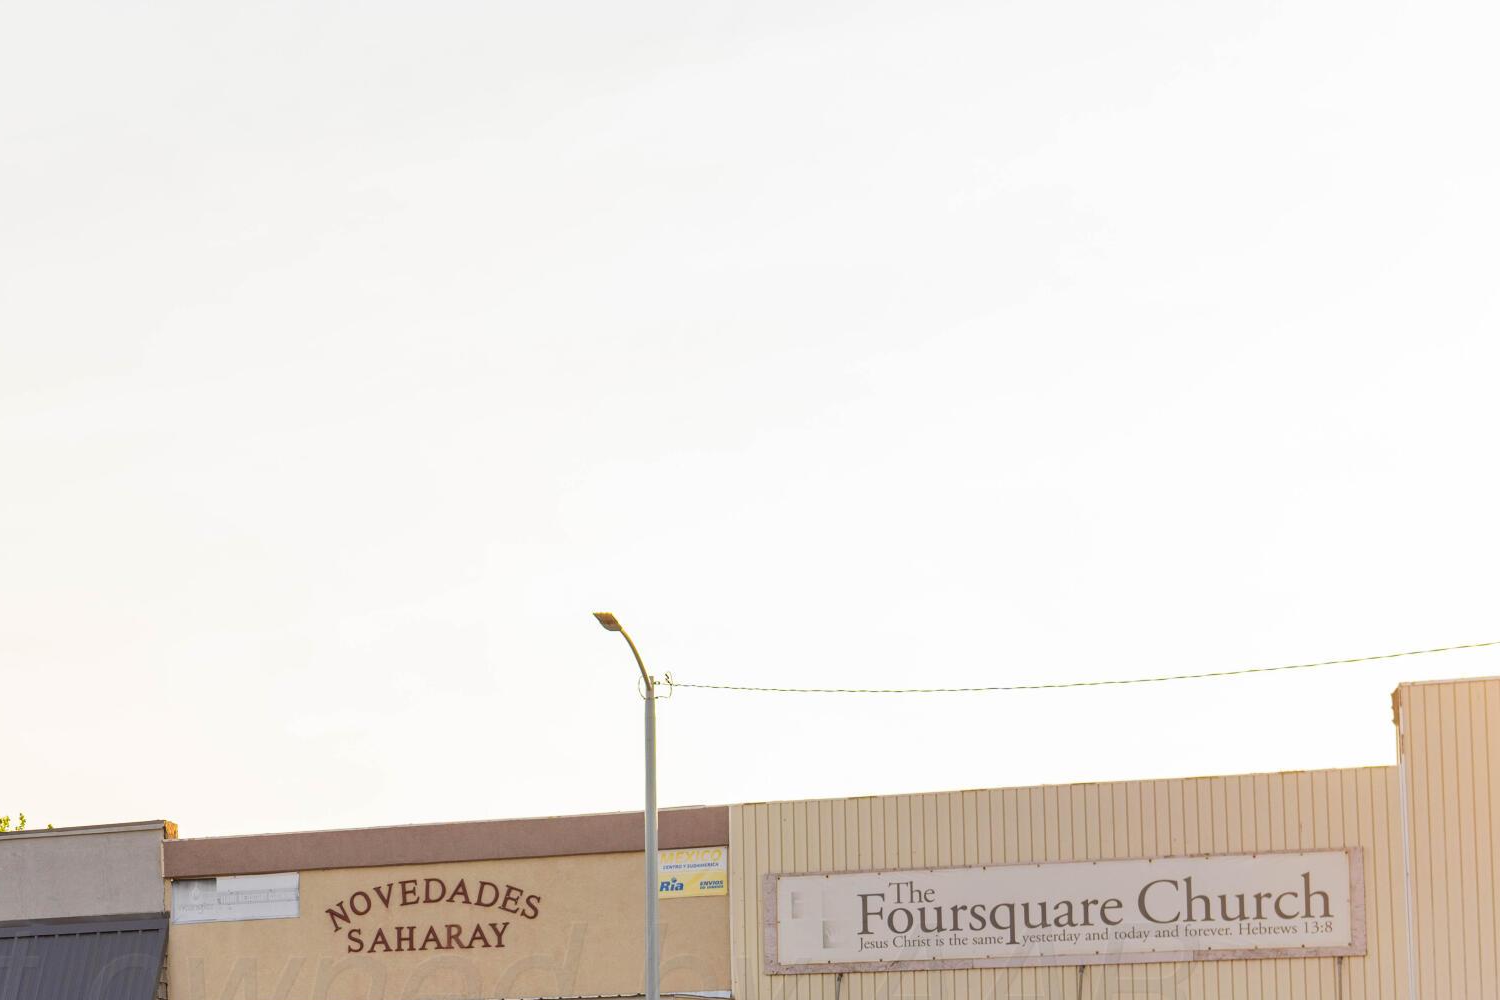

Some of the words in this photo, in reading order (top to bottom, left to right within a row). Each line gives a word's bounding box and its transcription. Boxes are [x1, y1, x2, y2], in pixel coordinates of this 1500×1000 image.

[660, 849, 723, 863] MEXICO
[659, 877, 684, 892] Ria
[888, 880, 936, 904] The
[325, 878, 541, 933] NOVEDADES
[856, 892, 1124, 945] Foursquare
[1137, 871, 1335, 924] Church
[347, 921, 510, 953] SAHARAY
[859, 937, 889, 952] Jesus
[892, 934, 931, 948] Christ
[935, 935, 944, 947] is
[949, 933, 968, 946] the
[972, 935, 1004, 945] same
[1022, 928, 1080, 947] yesterday
[1085, 928, 1109, 942] and
[1114, 925, 1151, 943] today
[1154, 924, 1180, 938] and
[1184, 923, 1233, 937] forever.
[1239, 921, 1298, 935] Hebrews
[1304, 920, 1333, 934] 13:8
